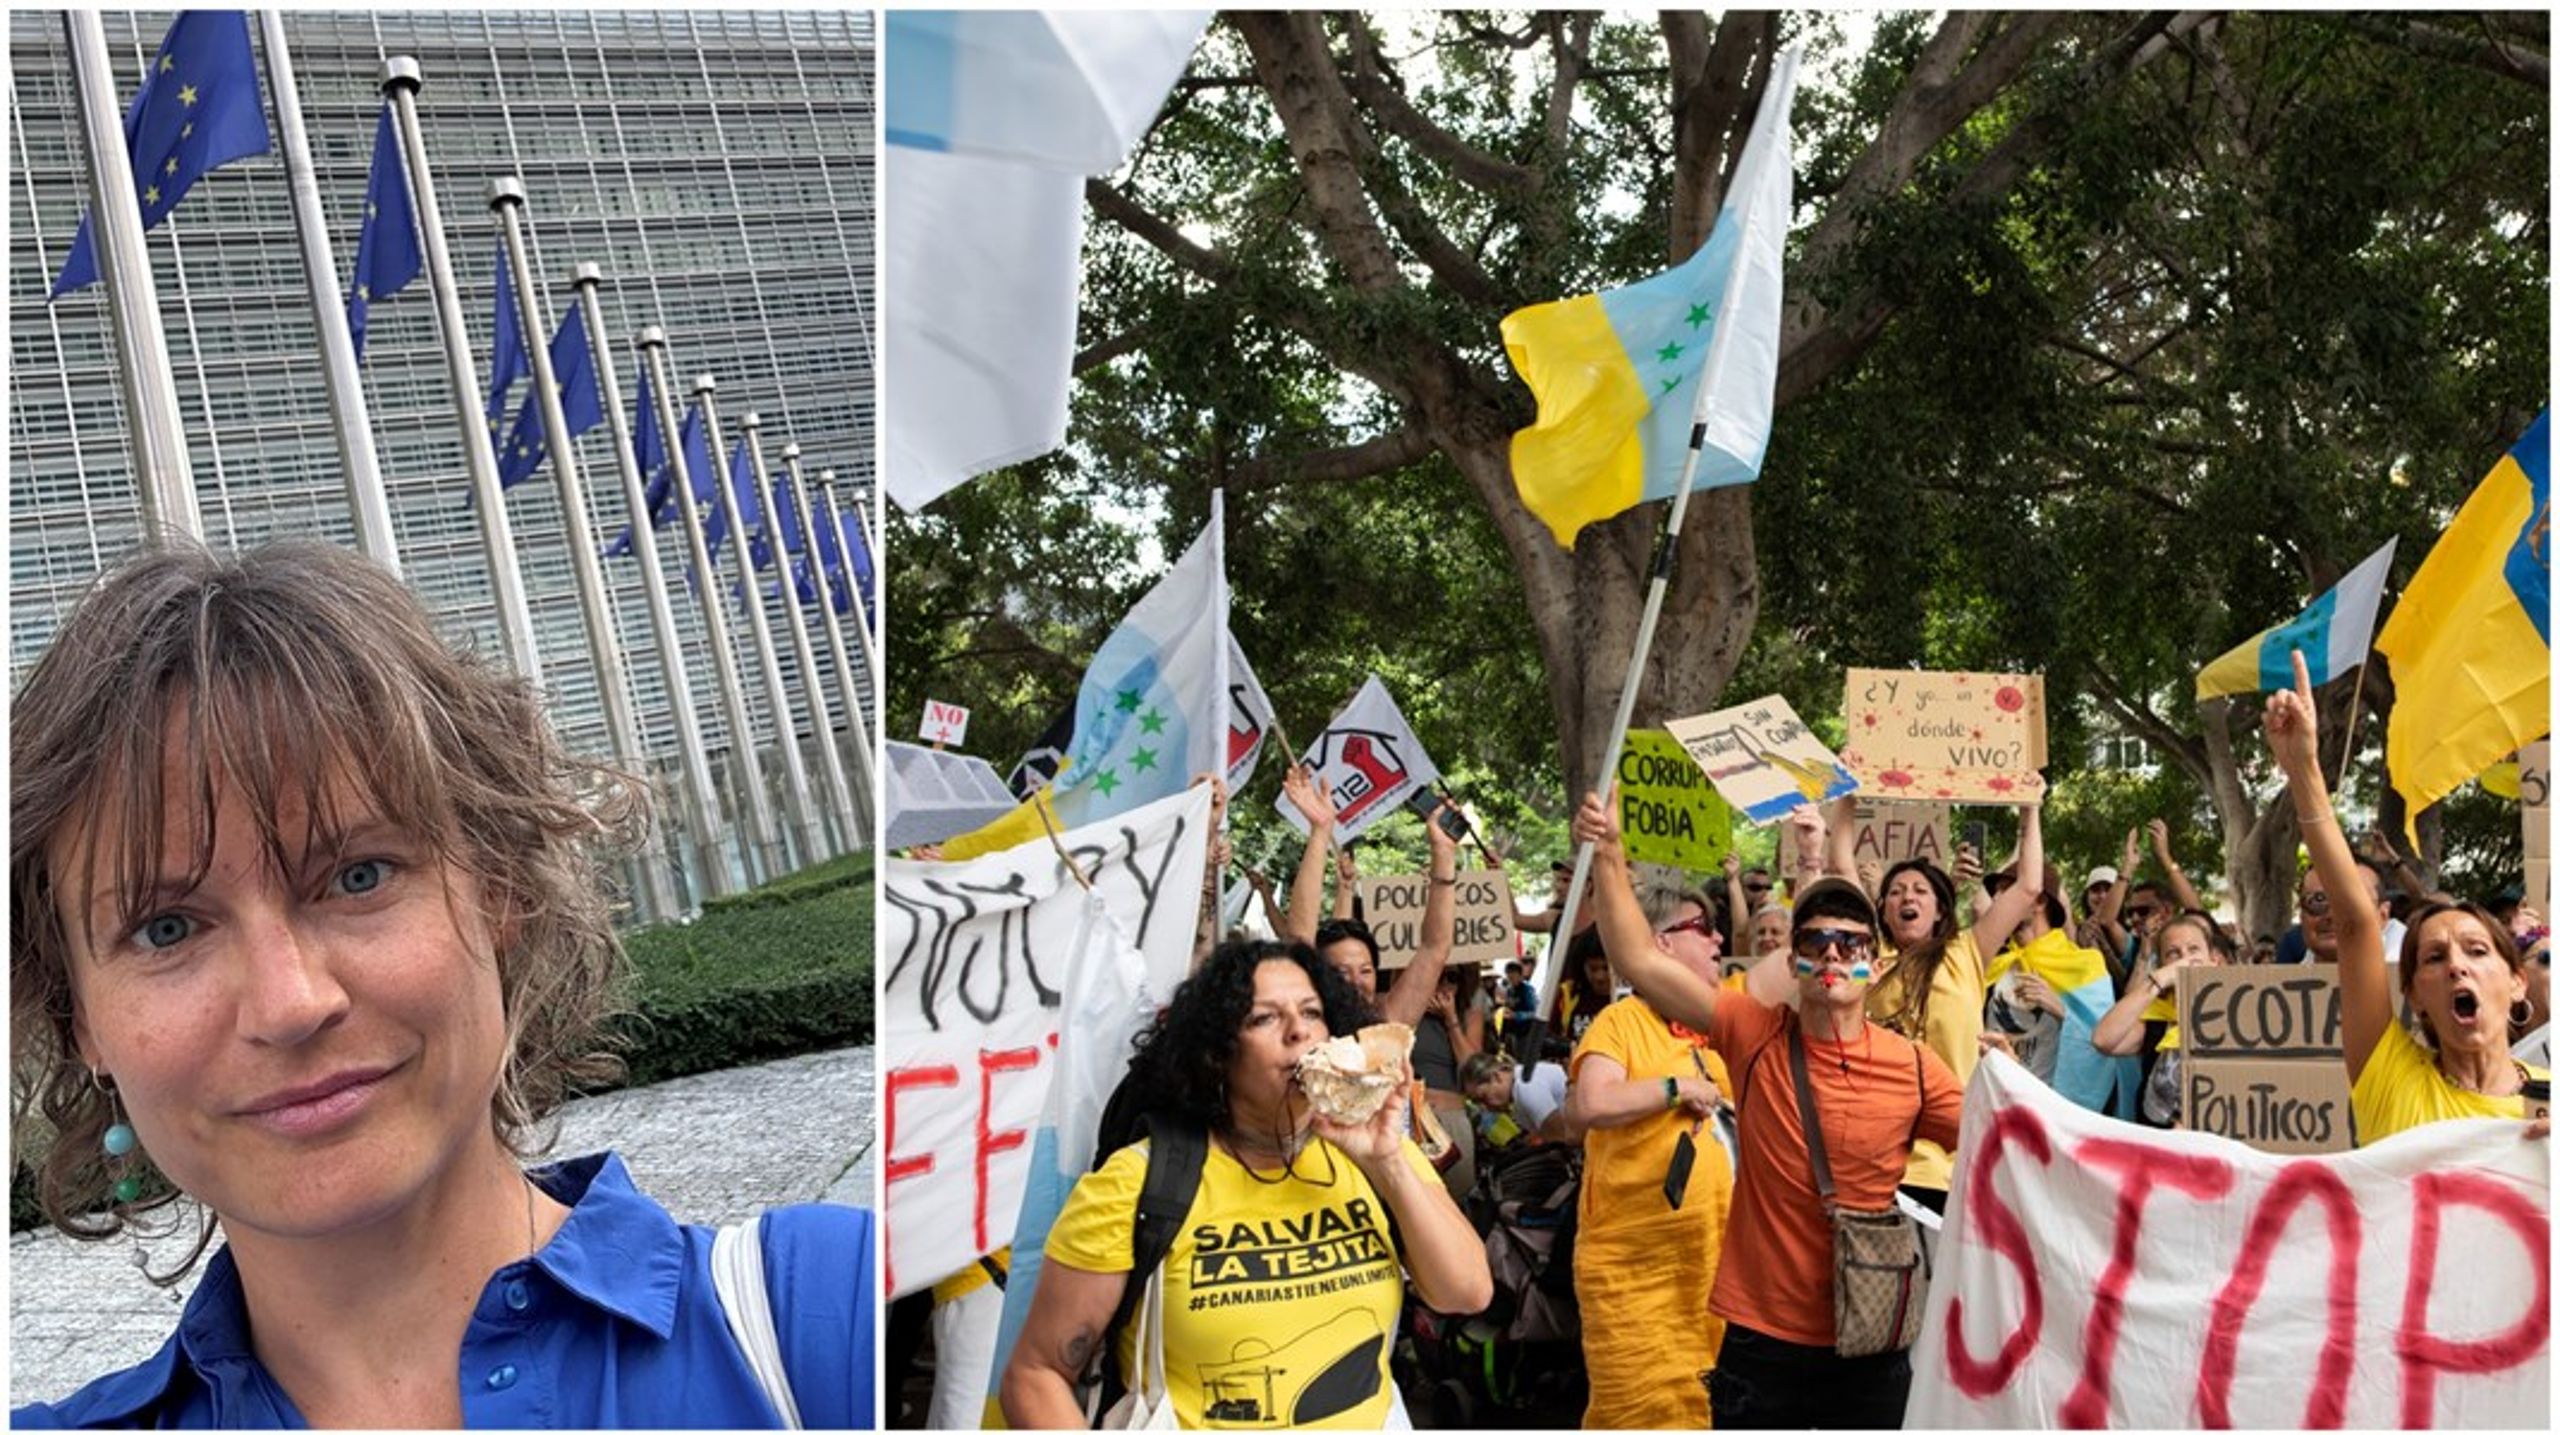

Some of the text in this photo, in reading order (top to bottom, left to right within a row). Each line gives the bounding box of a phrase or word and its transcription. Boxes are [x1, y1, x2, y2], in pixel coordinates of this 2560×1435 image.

[928, 703, 964, 726] NO
[1949, 741, 2023, 769] VIVO?
[1372, 913, 1508, 952] CULBLES
[1192, 1198, 1375, 1252] SALVAR
[1193, 1231, 1387, 1285] LA TEJITA
[1946, 1105, 2550, 1430] STOP
